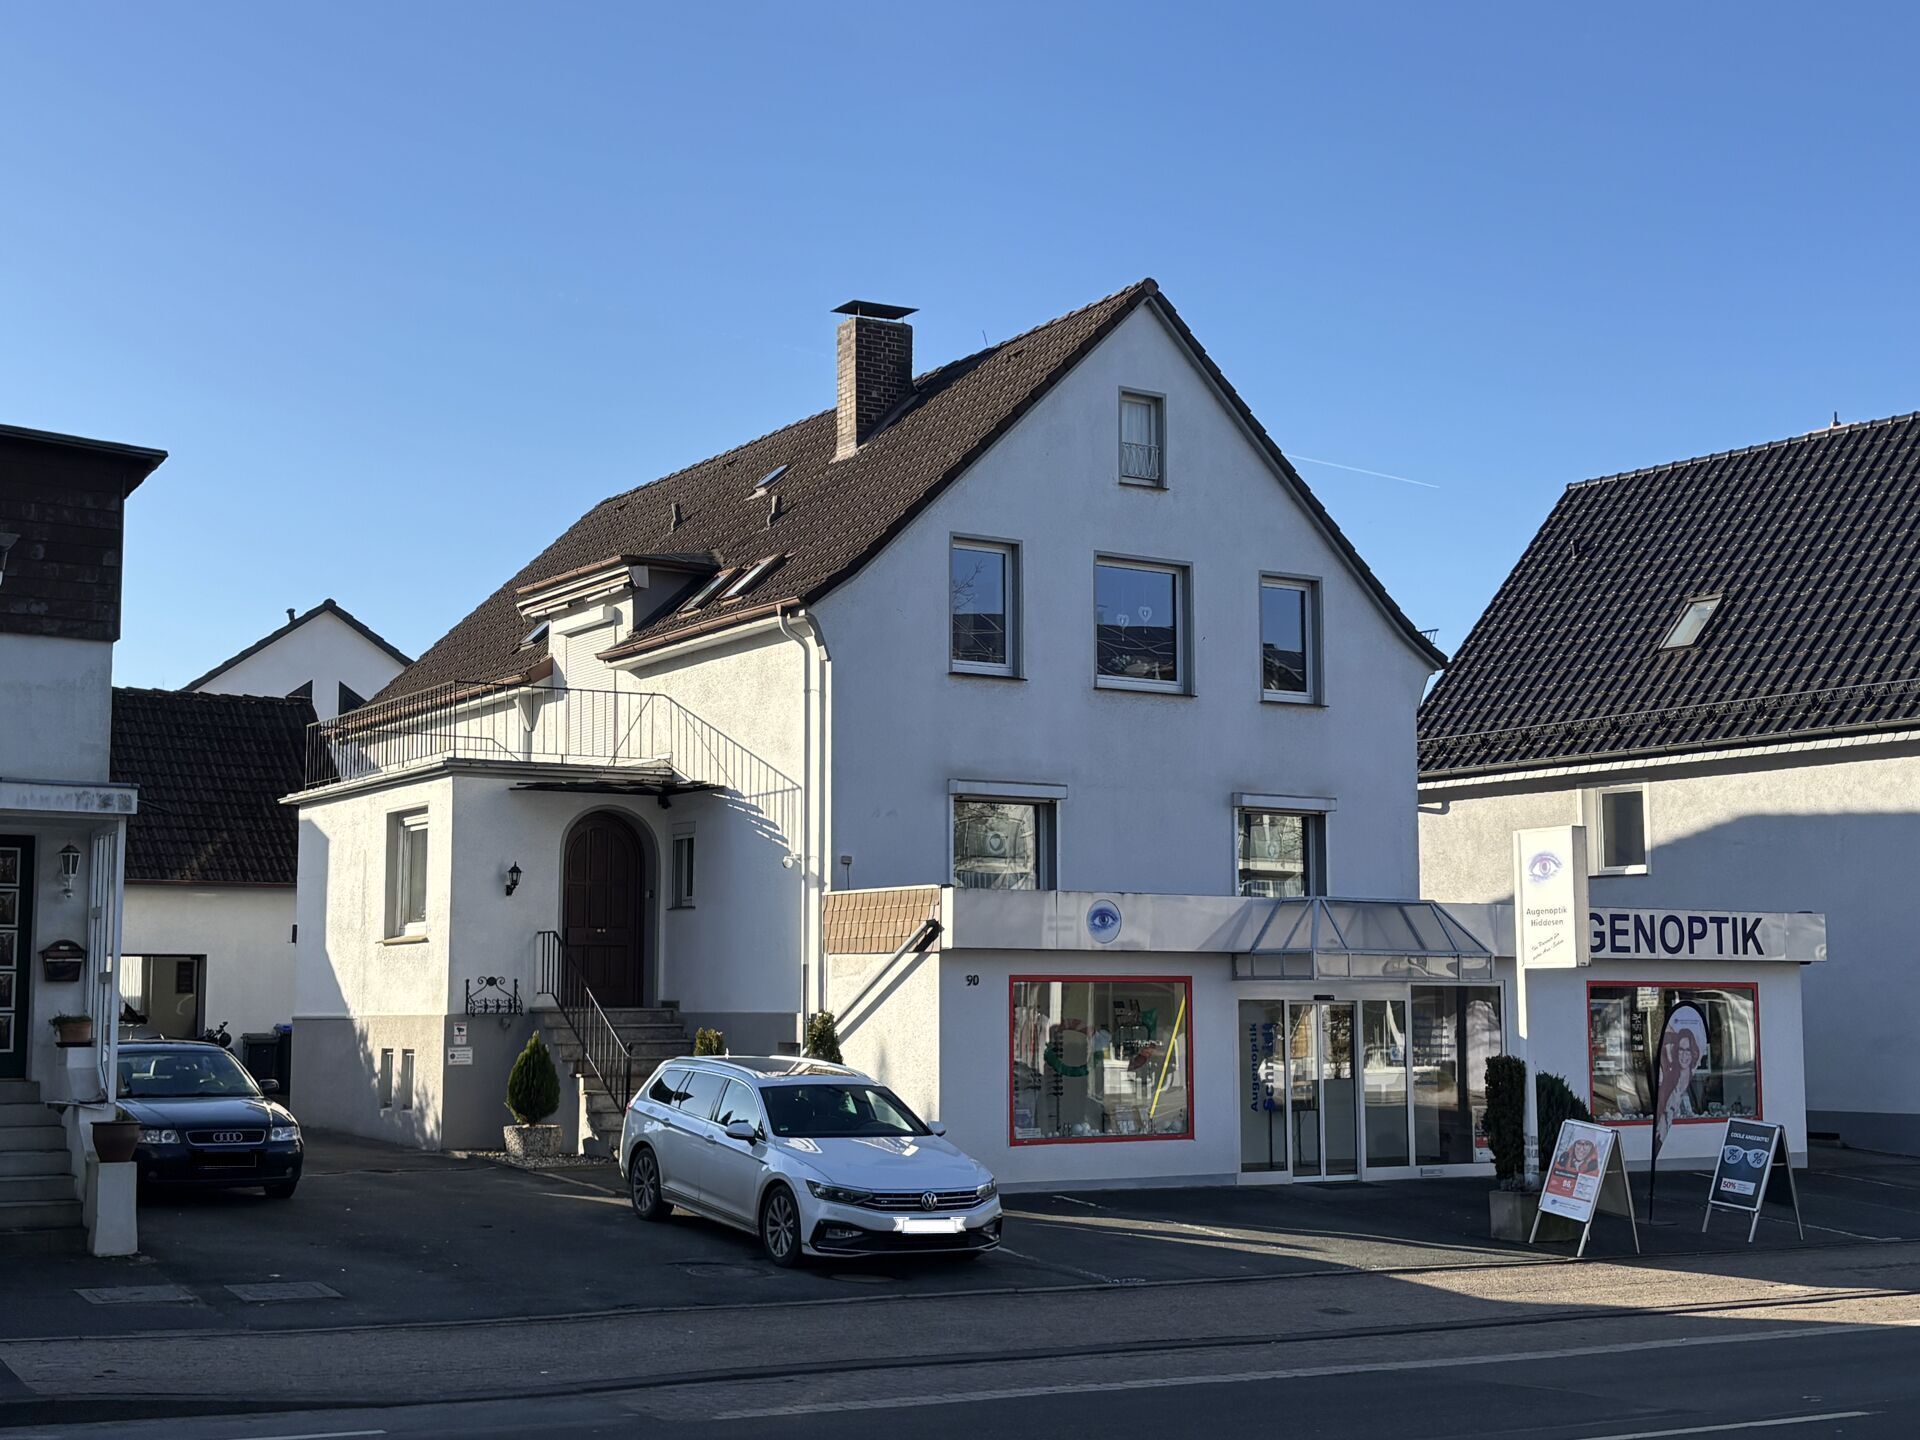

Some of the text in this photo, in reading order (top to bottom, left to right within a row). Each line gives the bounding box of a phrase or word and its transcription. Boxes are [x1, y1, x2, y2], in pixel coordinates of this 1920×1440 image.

[1526, 905, 1567, 917] Augenoptik
[966, 974, 980, 986] 90
[1249, 1023, 1260, 1113] Augenoptik
[1722, 1180, 1737, 1190] 50%
